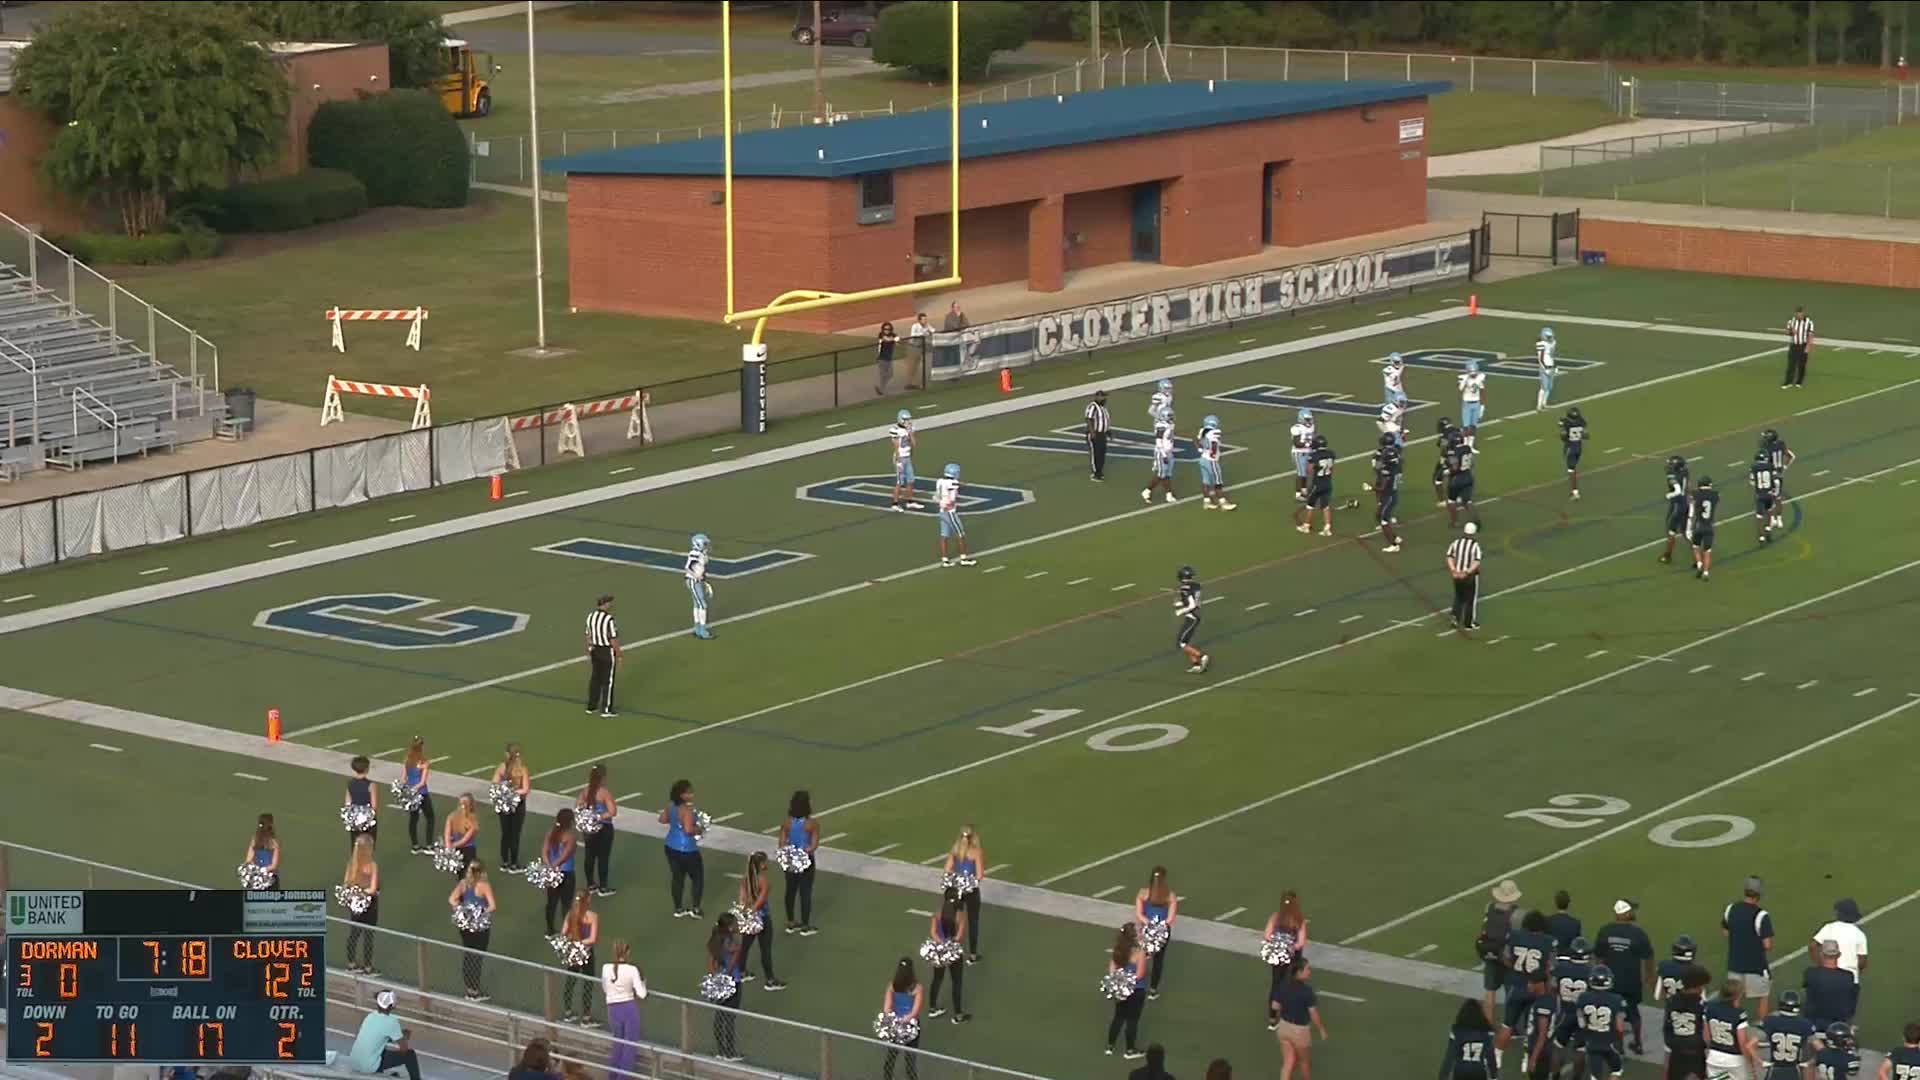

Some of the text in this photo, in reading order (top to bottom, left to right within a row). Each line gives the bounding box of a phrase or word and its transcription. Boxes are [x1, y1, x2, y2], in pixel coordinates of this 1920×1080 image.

[1037, 292, 1171, 357] CLOVER
[1187, 273, 1265, 327] HIGH
[1279, 252, 1390, 309] SCHOOL
[758, 363, 767, 432] CLOVER
[1701, 500, 1711, 519] 3
[1513, 946, 1543, 974] 76
[1462, 1042, 1484, 1062] 17
[1771, 1032, 1802, 1061] 35
